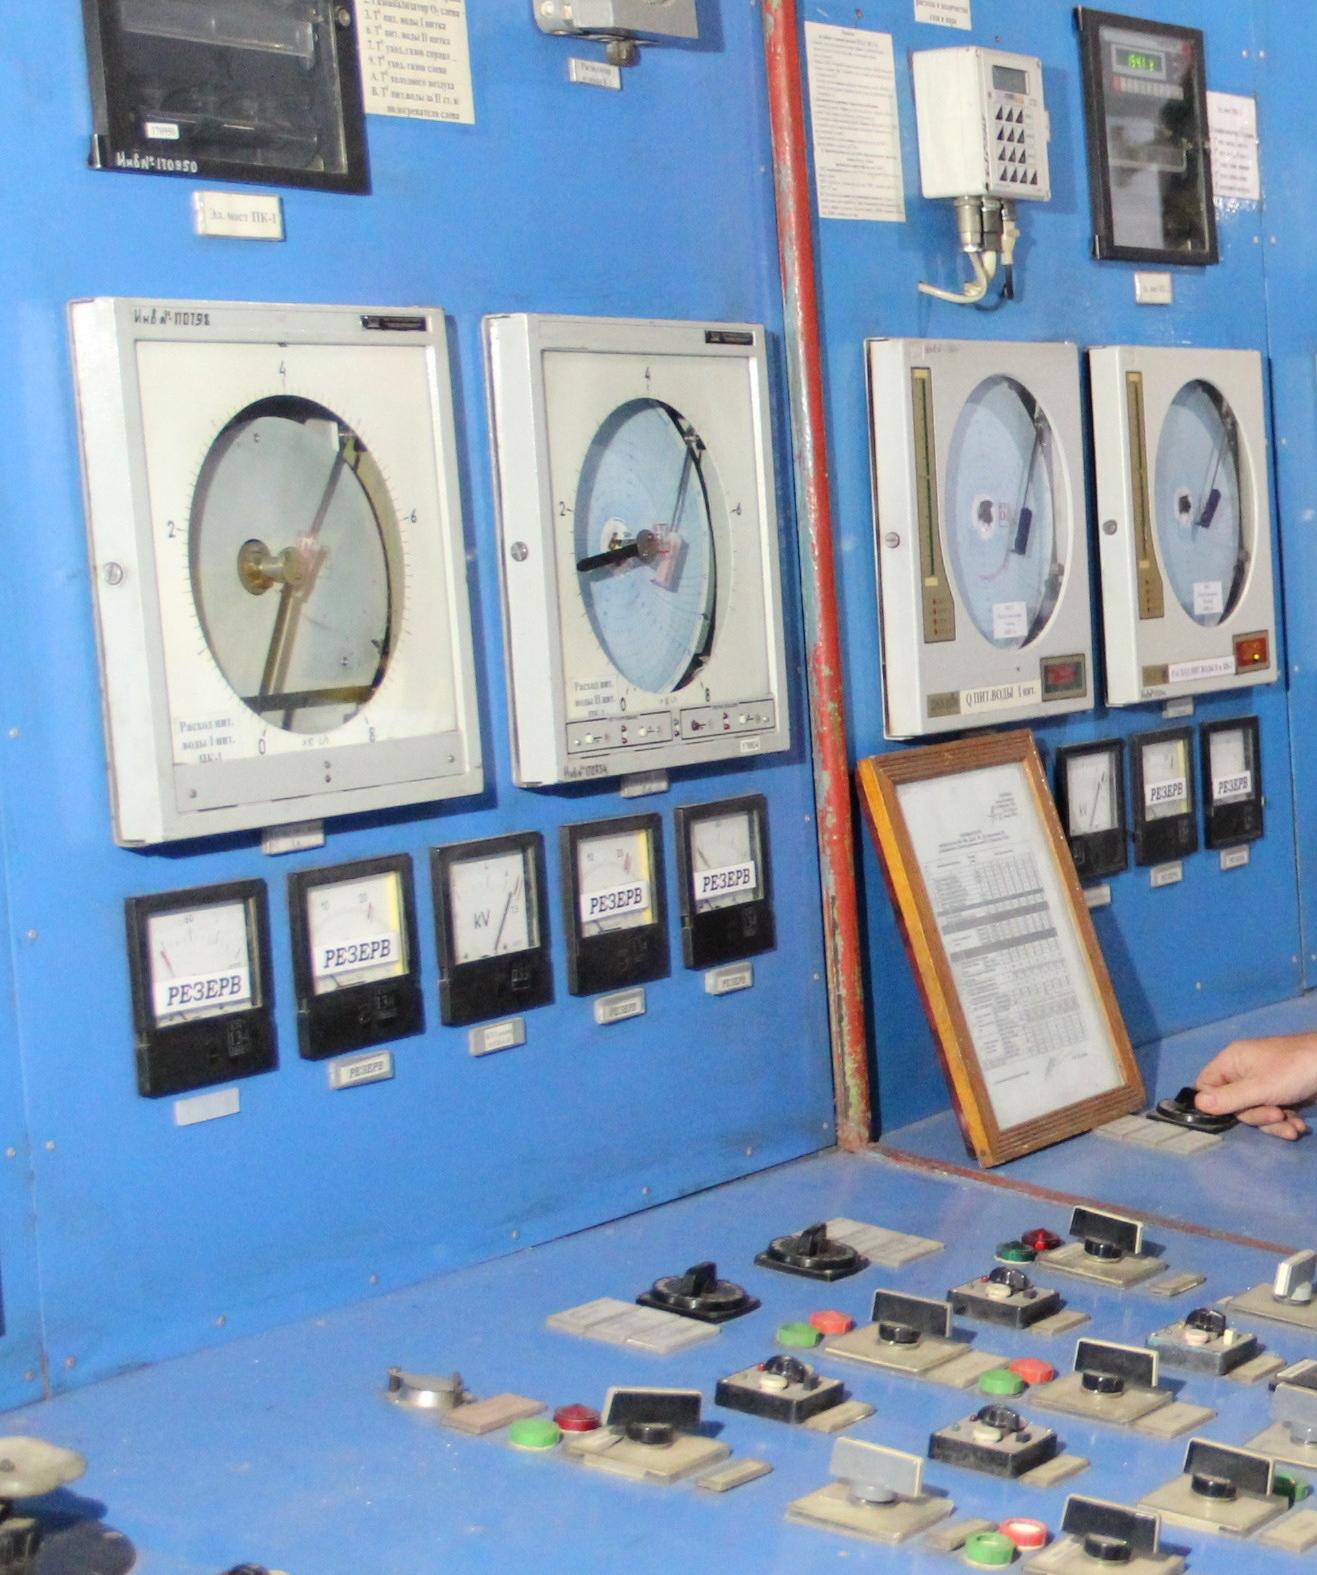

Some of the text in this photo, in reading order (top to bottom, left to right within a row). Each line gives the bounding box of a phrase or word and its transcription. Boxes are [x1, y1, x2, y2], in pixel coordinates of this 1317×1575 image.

[620, 696, 626, 712] 0
[258, 738, 266, 756] 0
[1150, 782, 1184, 801] РЕЗЕРВ
[1218, 776, 1249, 795] РЕЗЕРВ
[702, 867, 751, 894] РЕЗЕРВ
[589, 887, 643, 915] РЕЗЕРВ
[324, 938, 392, 969] РЕЗЕРВ
[167, 974, 242, 1007] РЕЗЕРВ
[350, 1060, 384, 1078] РЕЗЕРВ
